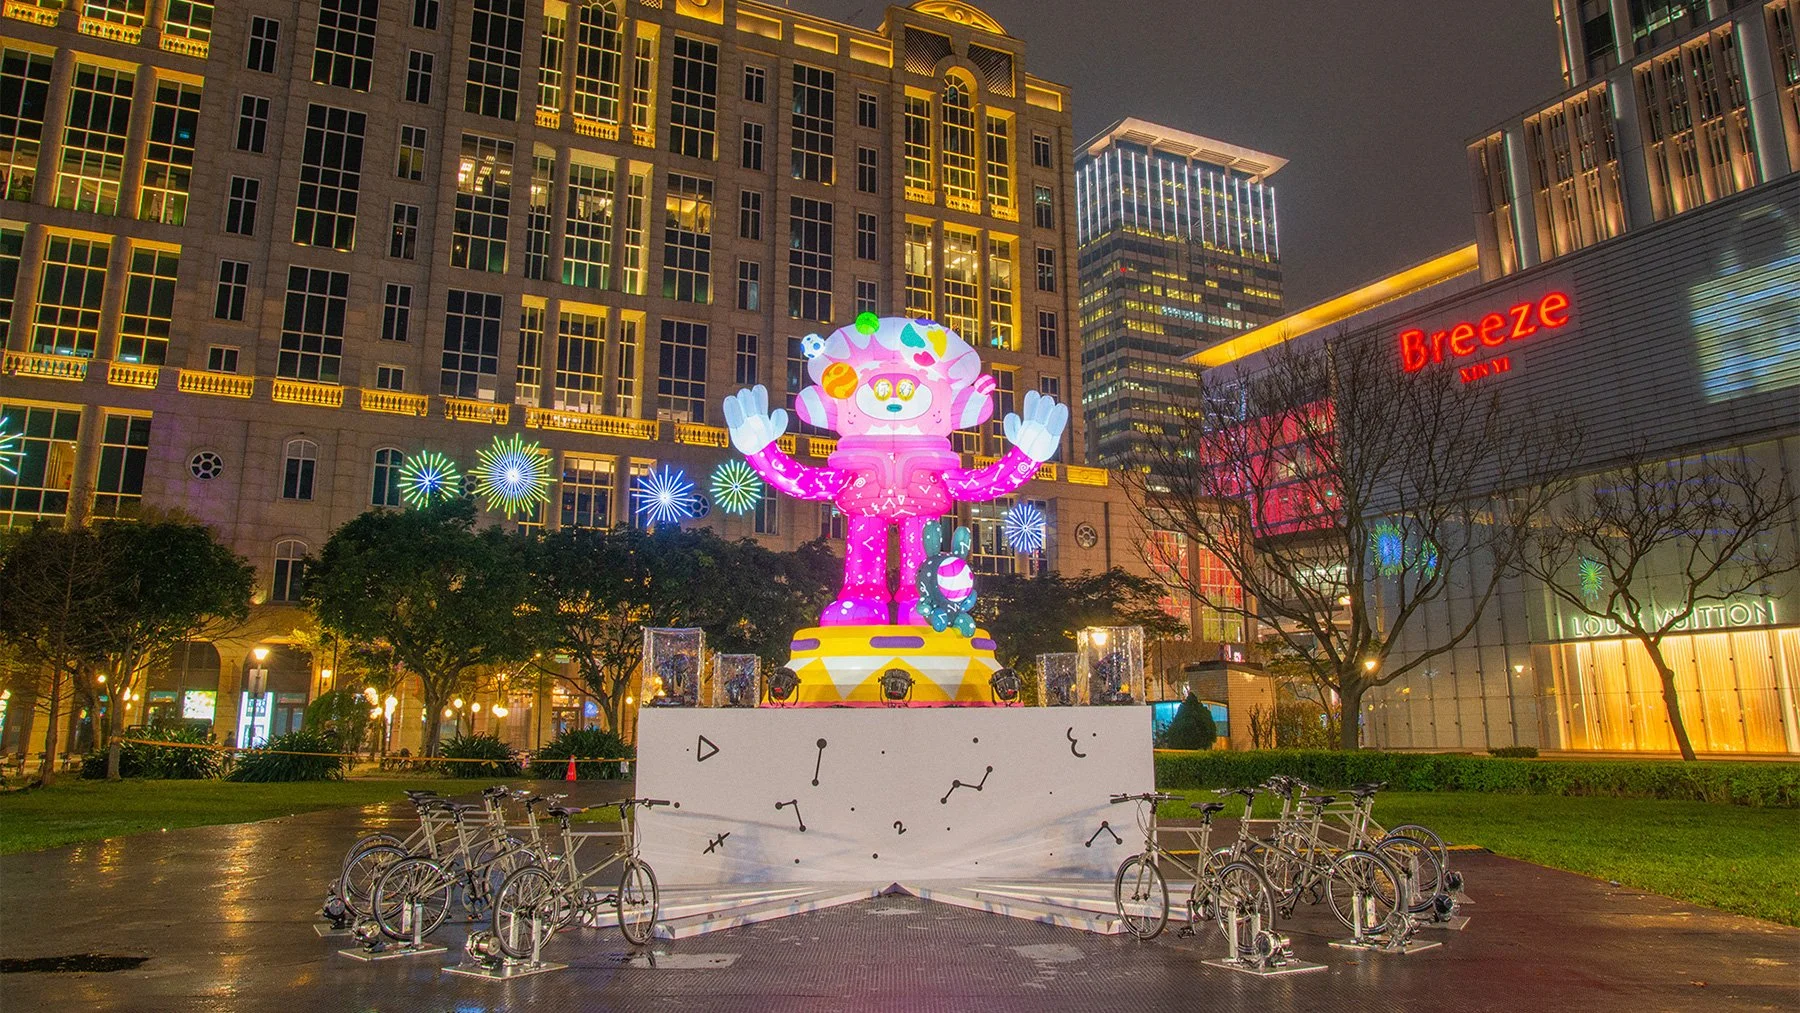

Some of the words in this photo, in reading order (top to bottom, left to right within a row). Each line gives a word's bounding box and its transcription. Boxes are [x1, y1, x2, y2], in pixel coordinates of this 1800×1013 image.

[1401, 291, 1569, 372] Breeze
[1459, 363, 1489, 383] XIN
[1491, 356, 1511, 374] YI
